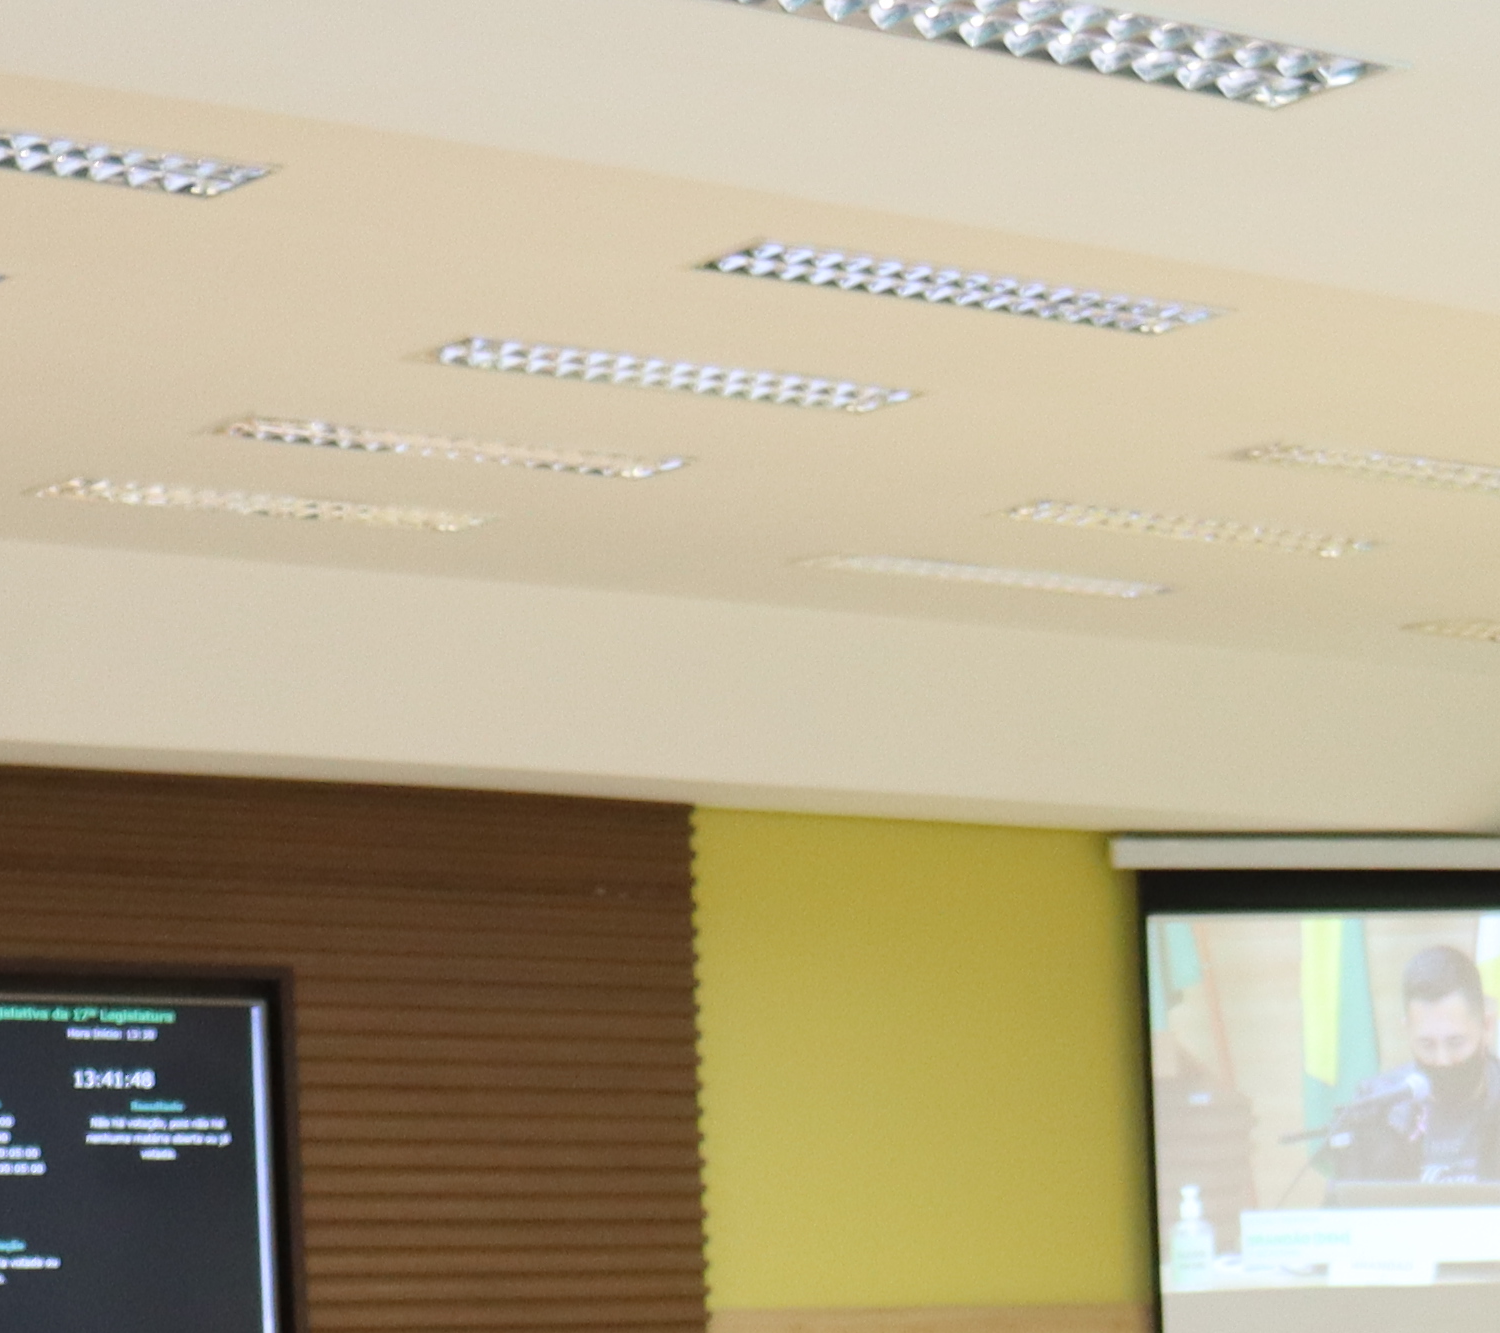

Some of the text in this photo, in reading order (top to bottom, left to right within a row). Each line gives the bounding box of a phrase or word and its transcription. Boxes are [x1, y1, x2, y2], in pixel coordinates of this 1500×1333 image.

[51, 1006, 69, 1021] da
[100, 1007, 177, 1025] Legislatura
[73, 1068, 155, 1089] 13:41:48
